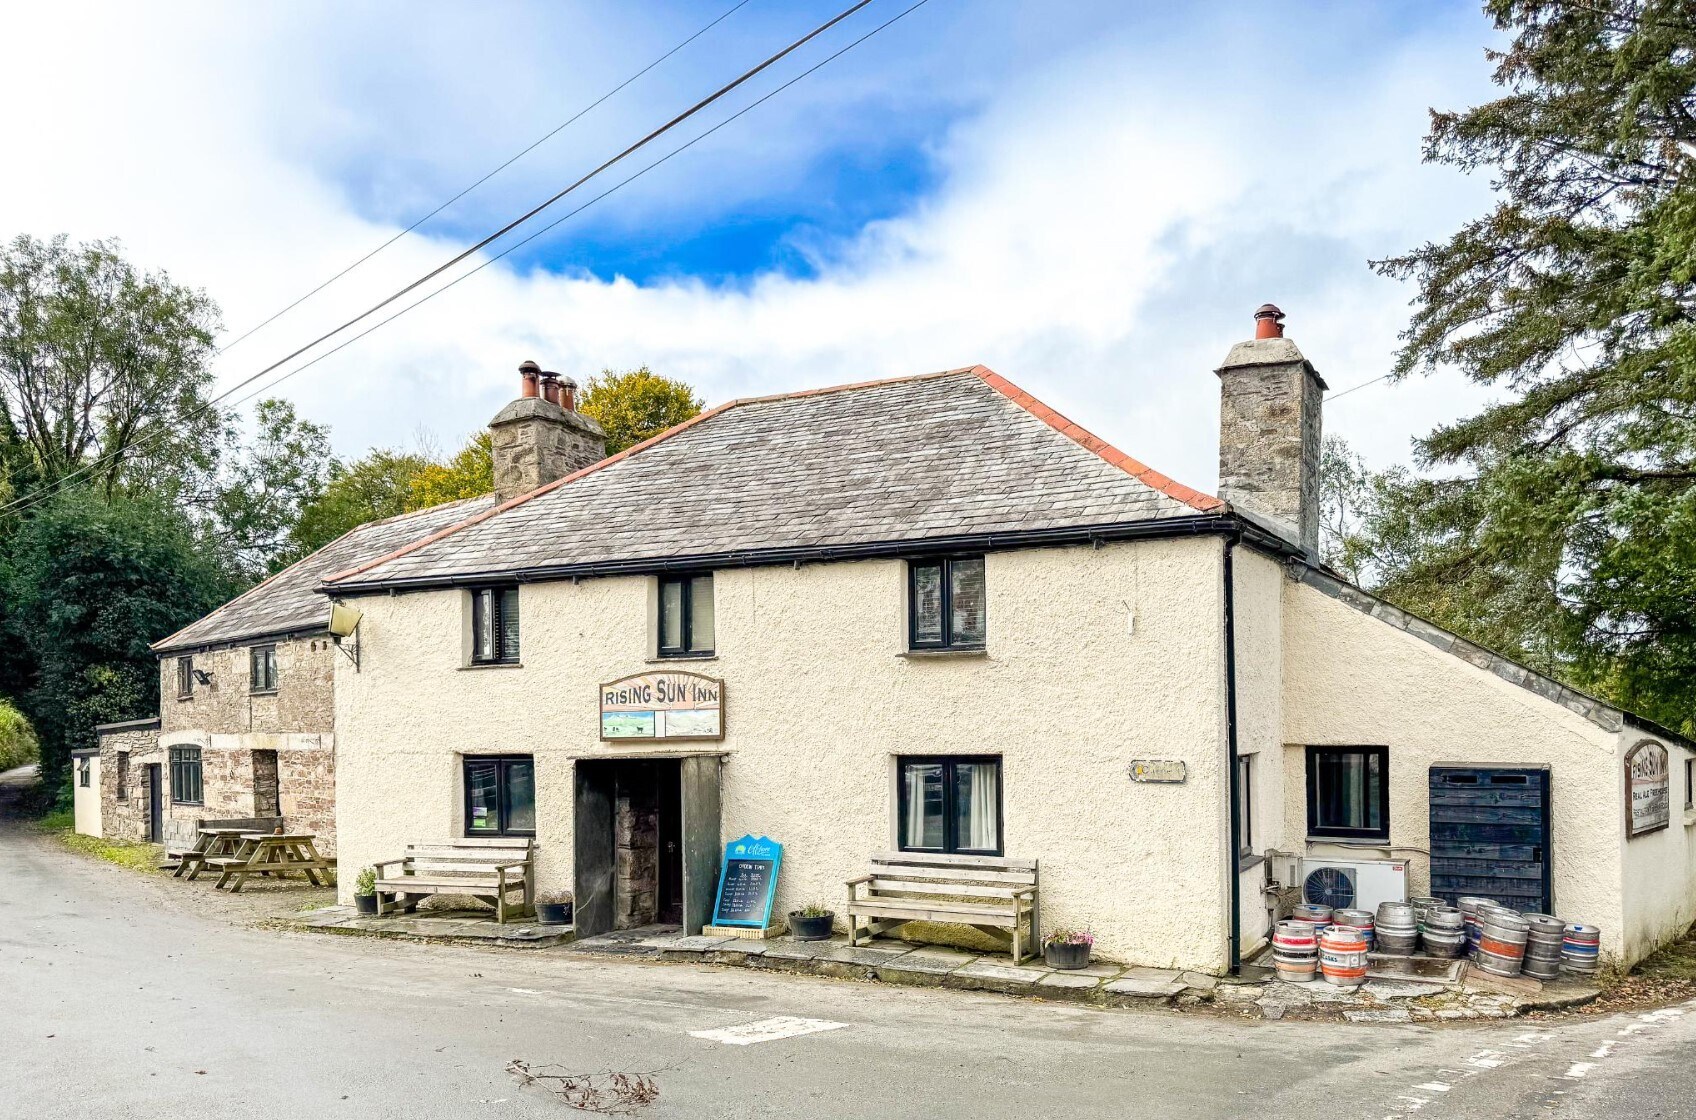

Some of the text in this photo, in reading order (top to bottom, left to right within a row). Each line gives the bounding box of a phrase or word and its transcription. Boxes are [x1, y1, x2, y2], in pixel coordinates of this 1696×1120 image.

[605, 679, 717, 704] RISING SUN INN
